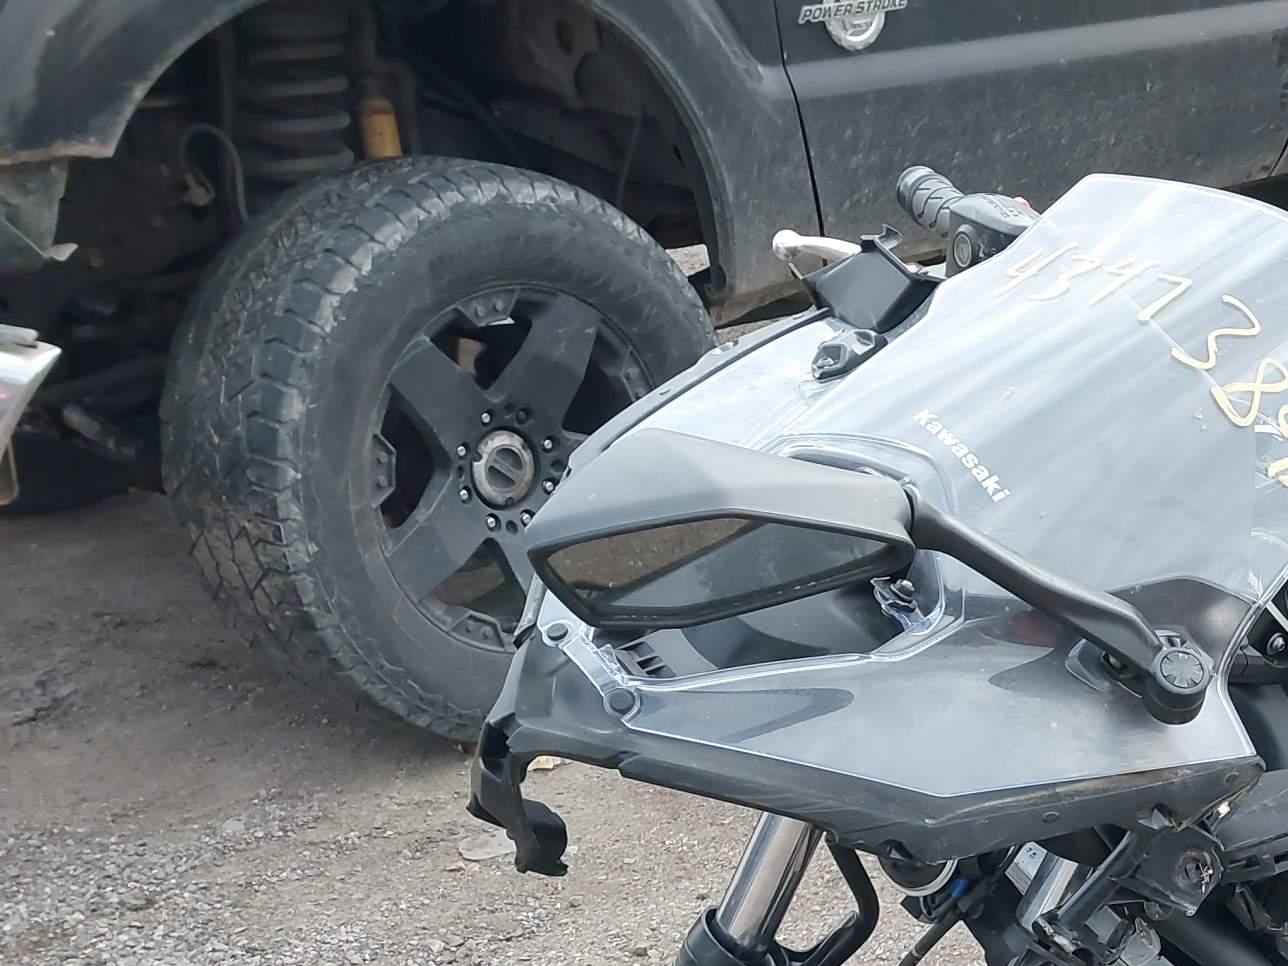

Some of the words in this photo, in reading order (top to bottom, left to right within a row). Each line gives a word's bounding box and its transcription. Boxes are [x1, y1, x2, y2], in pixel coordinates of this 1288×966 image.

[801, 4, 852, 21] POWER
[855, 0, 906, 14] STROKE
[912, 409, 1010, 504] Kawasaki
